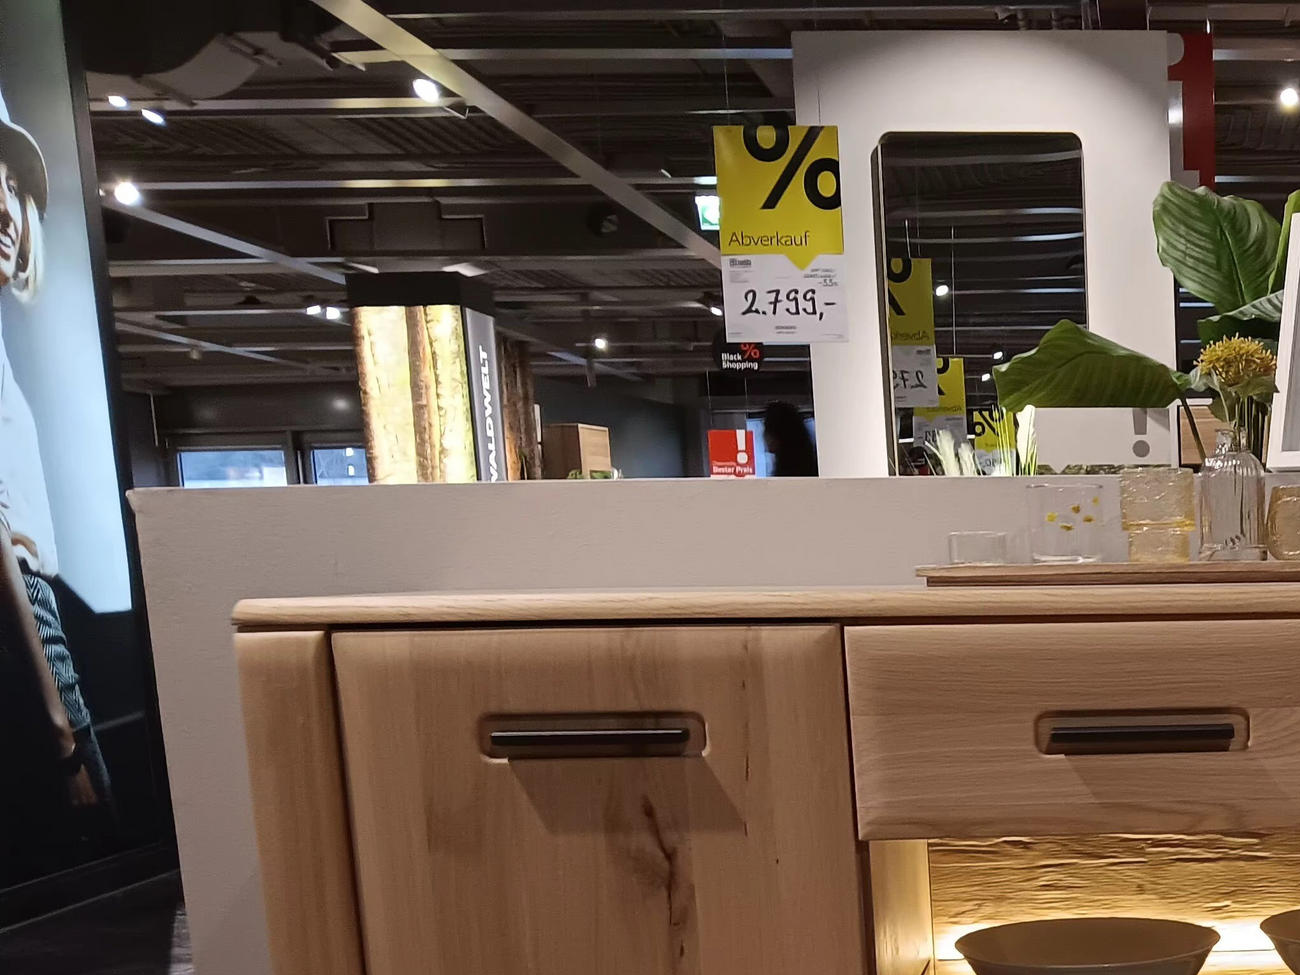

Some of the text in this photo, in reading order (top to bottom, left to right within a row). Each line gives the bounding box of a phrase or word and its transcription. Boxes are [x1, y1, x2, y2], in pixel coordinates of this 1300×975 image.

[728, 230, 810, 247] Abverkauf
[721, 352, 742, 361] Black
[722, 361, 759, 371] Shopping
